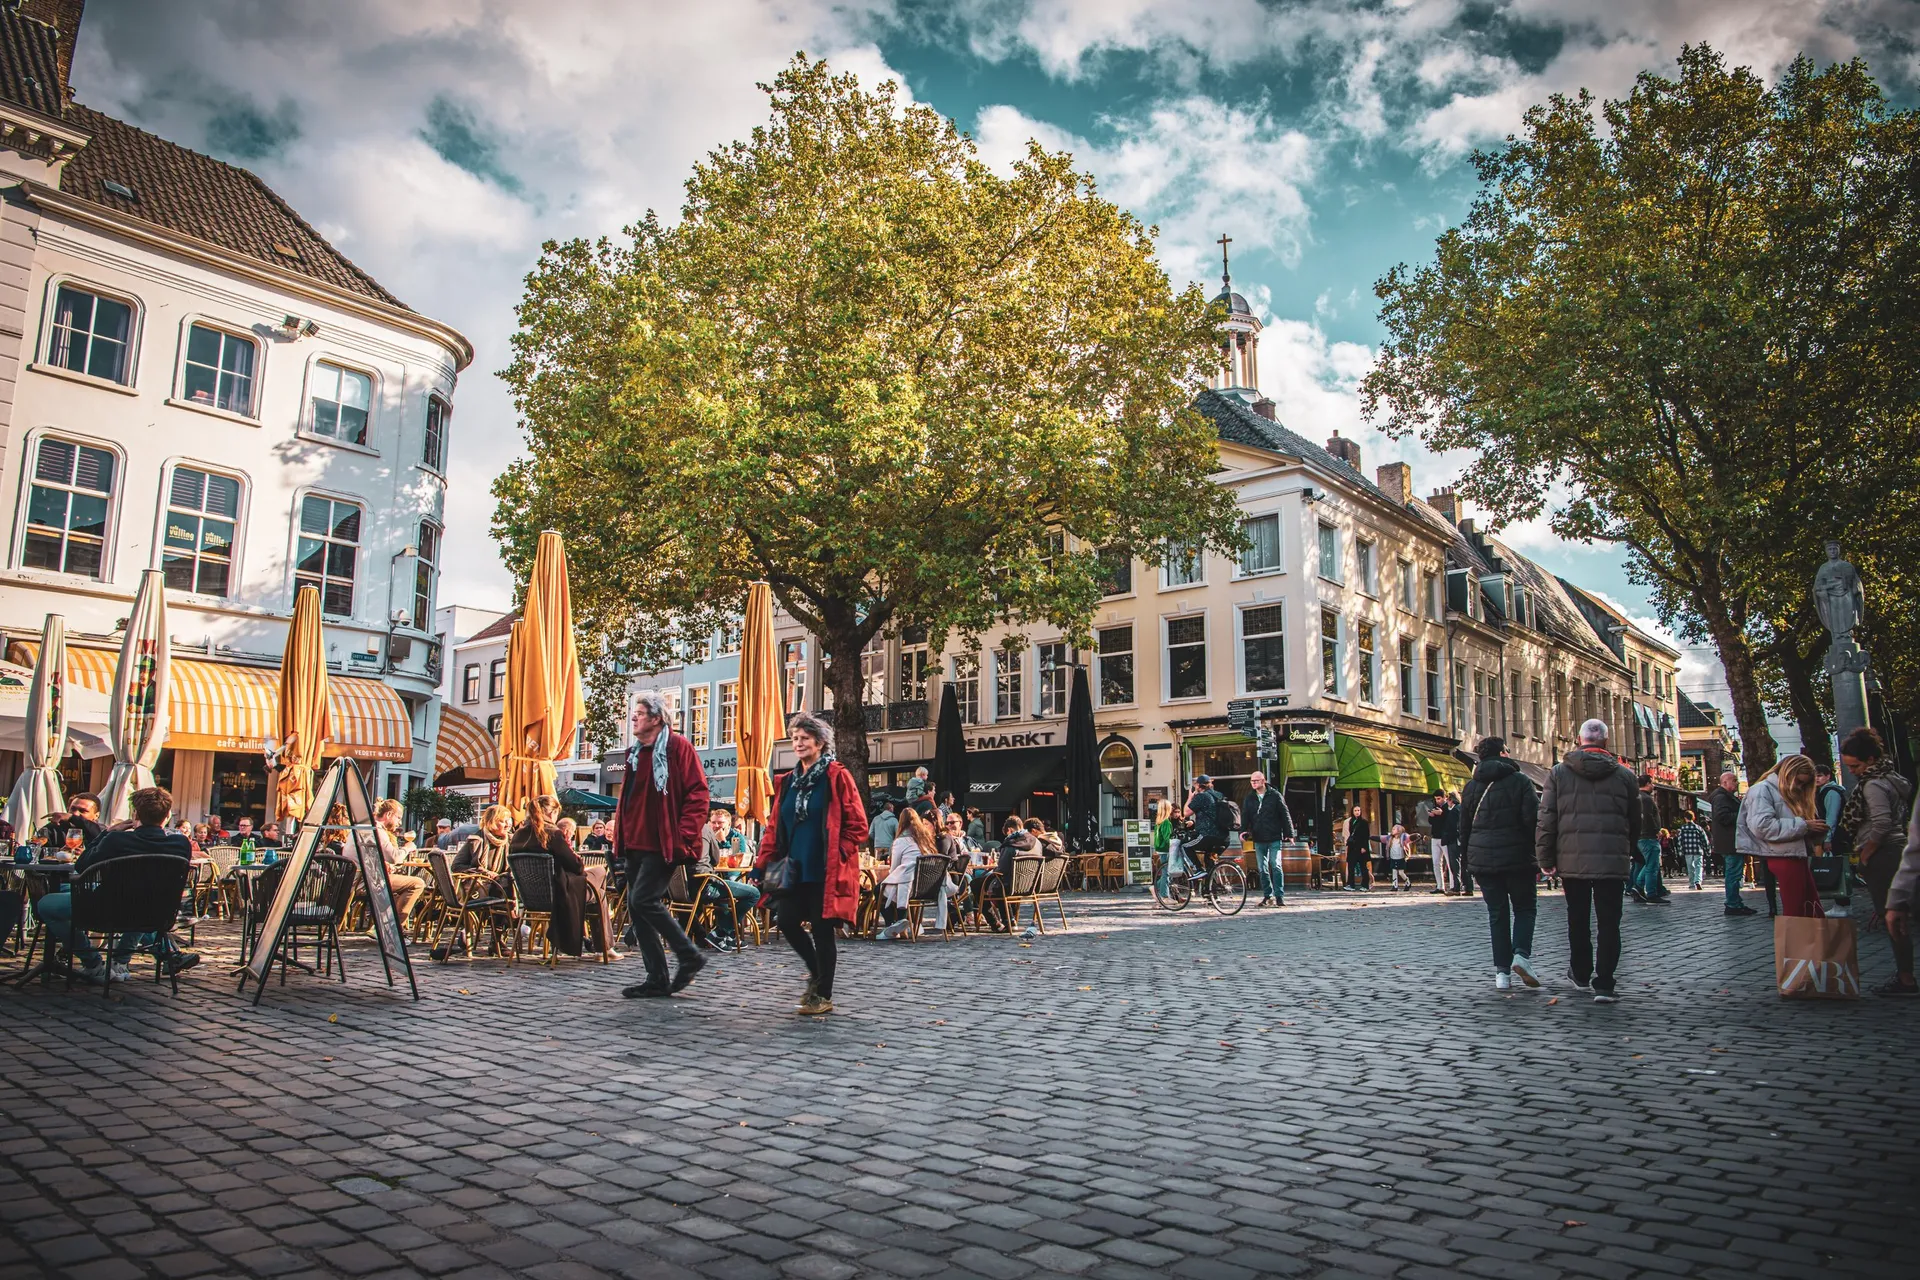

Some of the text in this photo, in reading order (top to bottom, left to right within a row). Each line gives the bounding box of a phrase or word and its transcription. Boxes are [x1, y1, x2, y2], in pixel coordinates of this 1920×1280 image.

[217, 738, 265, 750] café vullin
[977, 731, 1055, 750] MARKT
[355, 749, 376, 757] VEDETT
[704, 759, 715, 769] DE
[1781, 957, 1860, 994] ZARA
